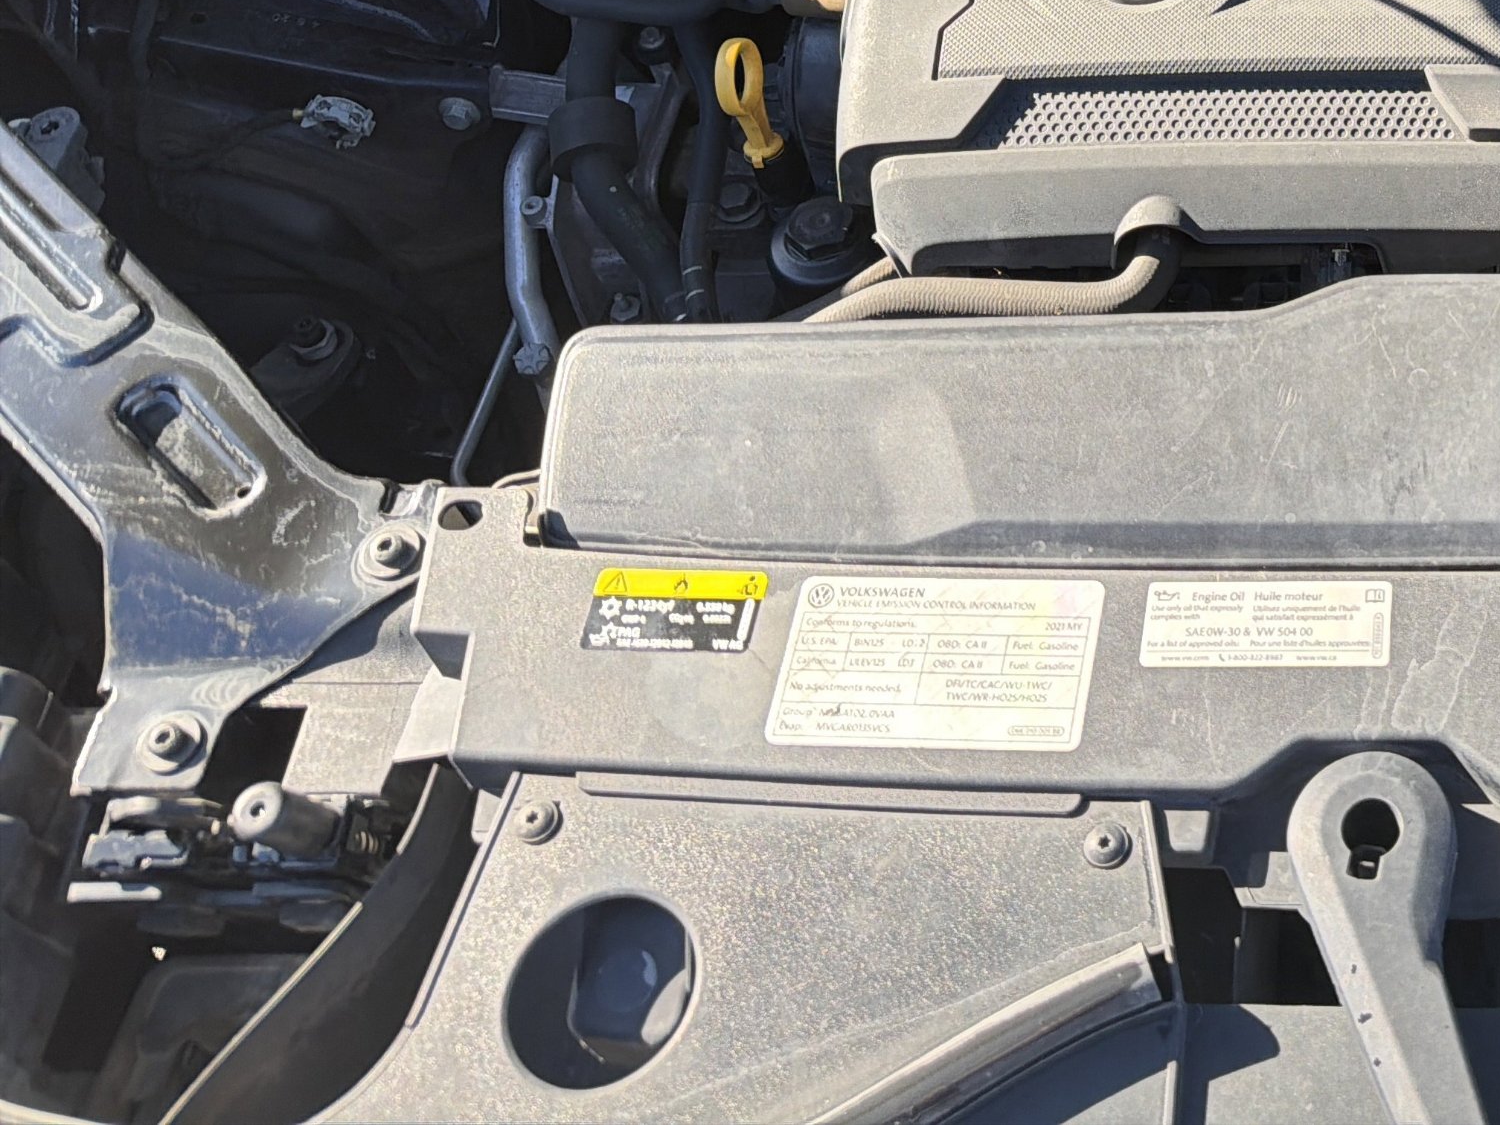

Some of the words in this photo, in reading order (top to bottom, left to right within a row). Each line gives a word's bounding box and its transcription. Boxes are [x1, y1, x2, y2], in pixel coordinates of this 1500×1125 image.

[840, 586, 925, 597] VOLKSWAGEN
[1192, 591, 1227, 604] Engine
[1230, 591, 1245, 601] Oil
[1254, 592, 1281, 601] Huile
[1284, 593, 1324, 601] moteur
[876, 600, 921, 608] EMISSION
[923, 600, 967, 609] CONTROL
[969, 601, 1036, 610] INFORMATION
[806, 617, 850, 627] Conforms
[1045, 622, 1065, 631] 2021
[1067, 622, 1083, 631] MY
[1185, 627, 1205, 636] SAE
[1206, 627, 1240, 636] 0W-30
[1243, 627, 1251, 636] &
[1256, 627, 1275, 636] VW
[1300, 627, 1313, 636] 00
[965, 640, 978, 649] CA
[1039, 641, 1079, 651] Gasoline
[1189, 640, 1223, 648] approved
[962, 660, 975, 668] CA
[1035, 662, 1075, 670] Gasoline
[790, 681, 803, 690] No
[805, 684, 862, 692] adjustments
